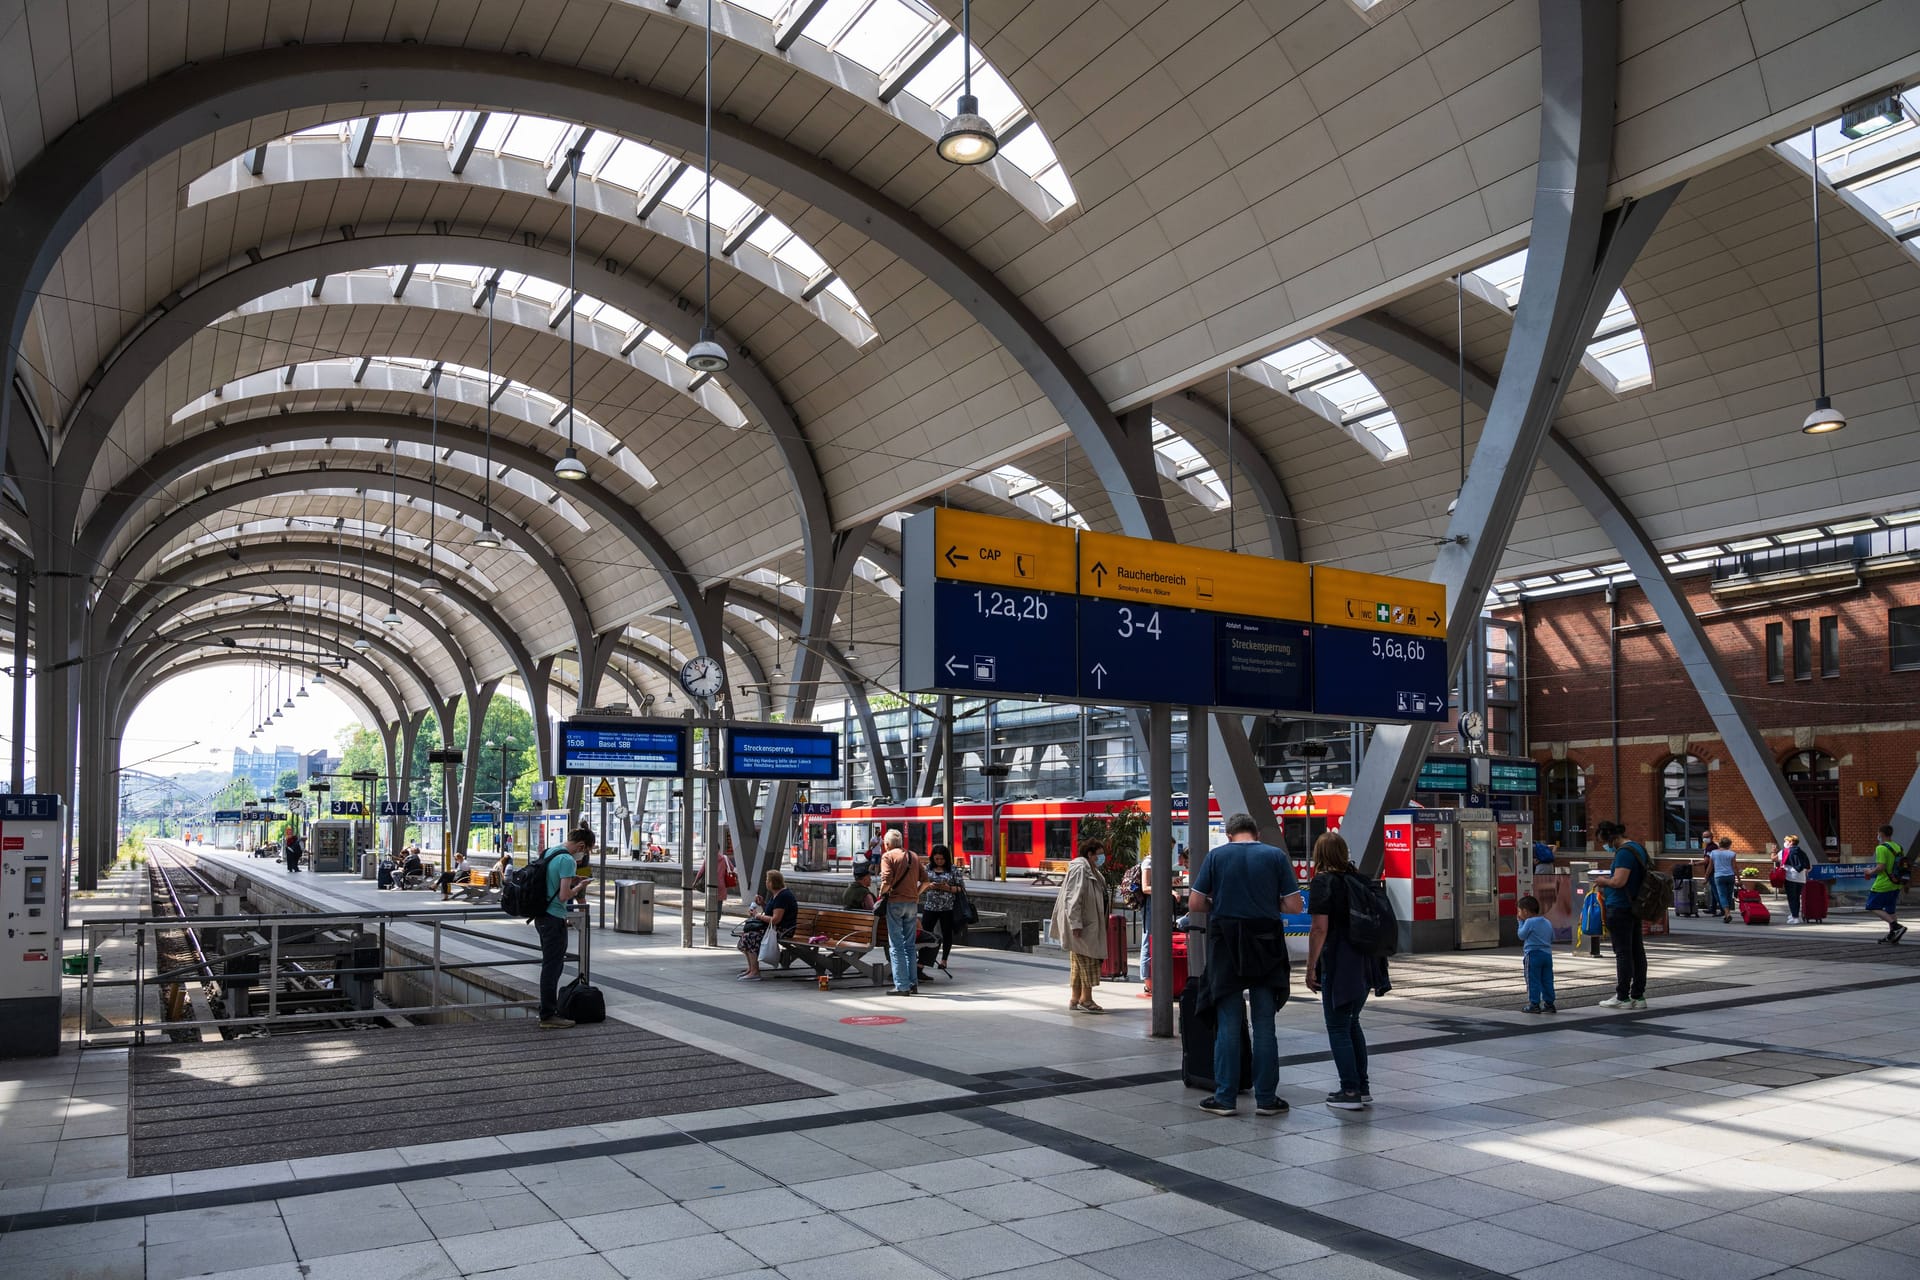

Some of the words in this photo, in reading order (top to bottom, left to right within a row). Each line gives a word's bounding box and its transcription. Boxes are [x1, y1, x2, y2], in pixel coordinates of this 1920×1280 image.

[979, 547, 1001, 560] CAP
[1117, 566, 1186, 586] Raucherbereich
[973, 589, 1048, 621] 1,2a,2b
[1361, 611, 1372, 619] WC
[1118, 607, 1162, 641] 3-4
[1231, 638, 1292, 656] Streckensperrung
[1372, 636, 1425, 662] 5,6a,6b
[598, 740, 616, 748] Basel
[743, 744, 794, 754] Streckensperrung
[1173, 799, 1184, 807] Kiel
[1470, 794, 1479, 804] 6b
[333, 802, 341, 812] 3
[349, 802, 359, 812] A
[385, 802, 395, 813] A
[402, 802, 410, 813] 4
[792, 804, 798, 812] A
[808, 804, 814, 812] A
[820, 804, 830, 812] 6a
